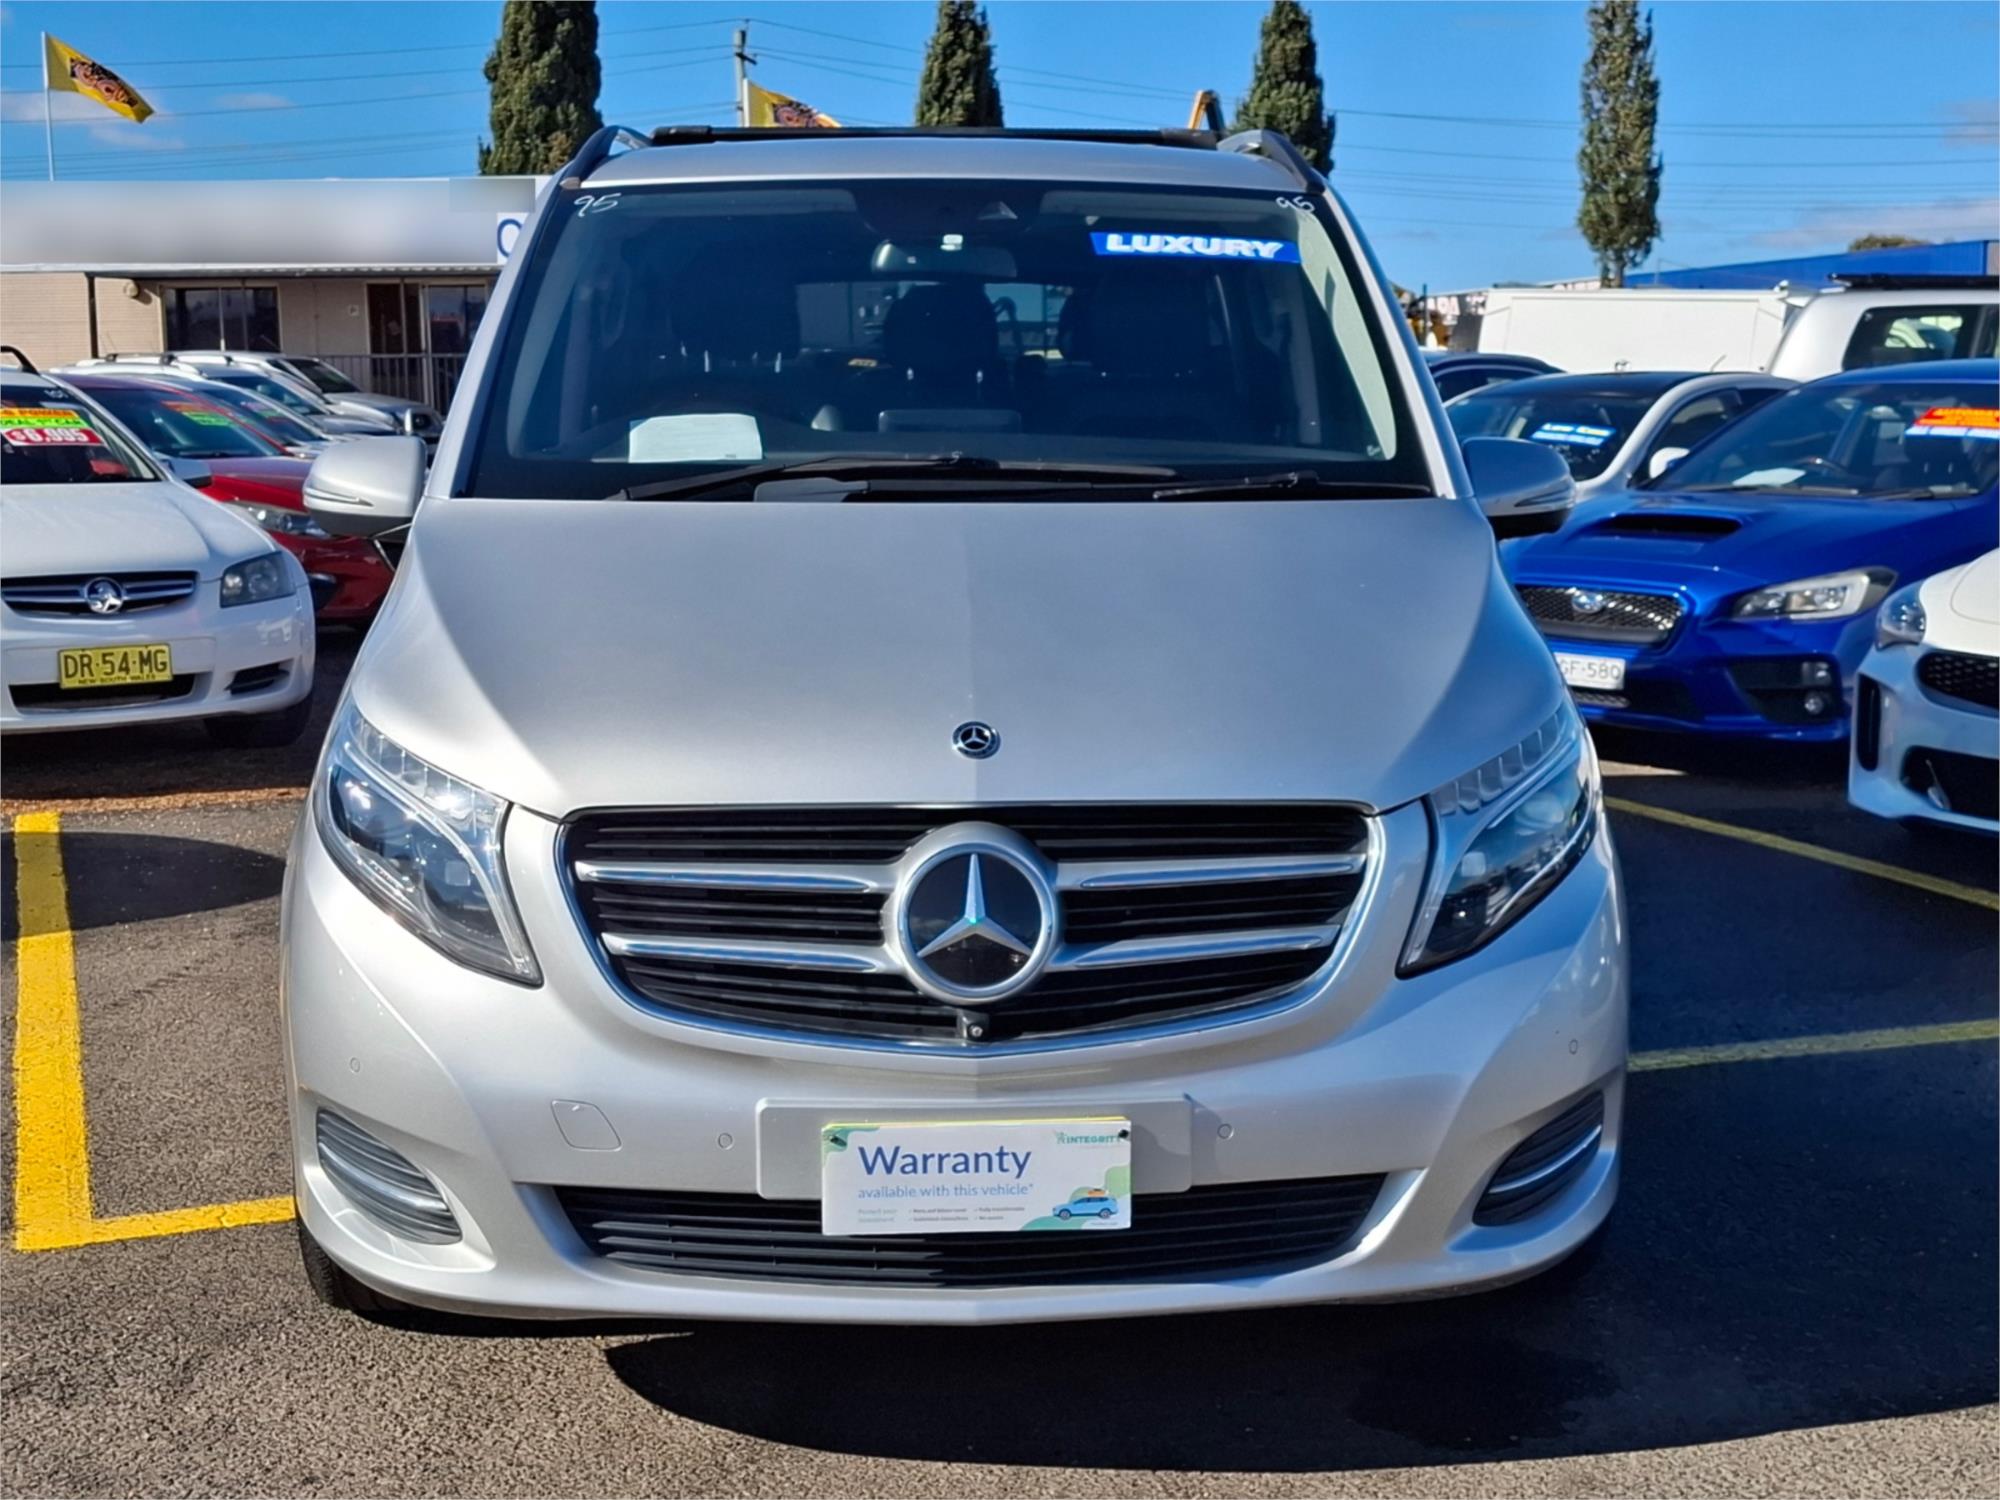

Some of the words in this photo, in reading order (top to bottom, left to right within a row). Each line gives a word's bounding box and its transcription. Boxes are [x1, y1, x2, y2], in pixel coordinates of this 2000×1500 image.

[574, 192, 622, 217] 95
[1106, 233, 1284, 259] LUXURY
[858, 1145, 1032, 1179] Warranty
[858, 1185, 917, 1199] available
[919, 1184, 950, 1197] with
[953, 1183, 978, 1196] this
